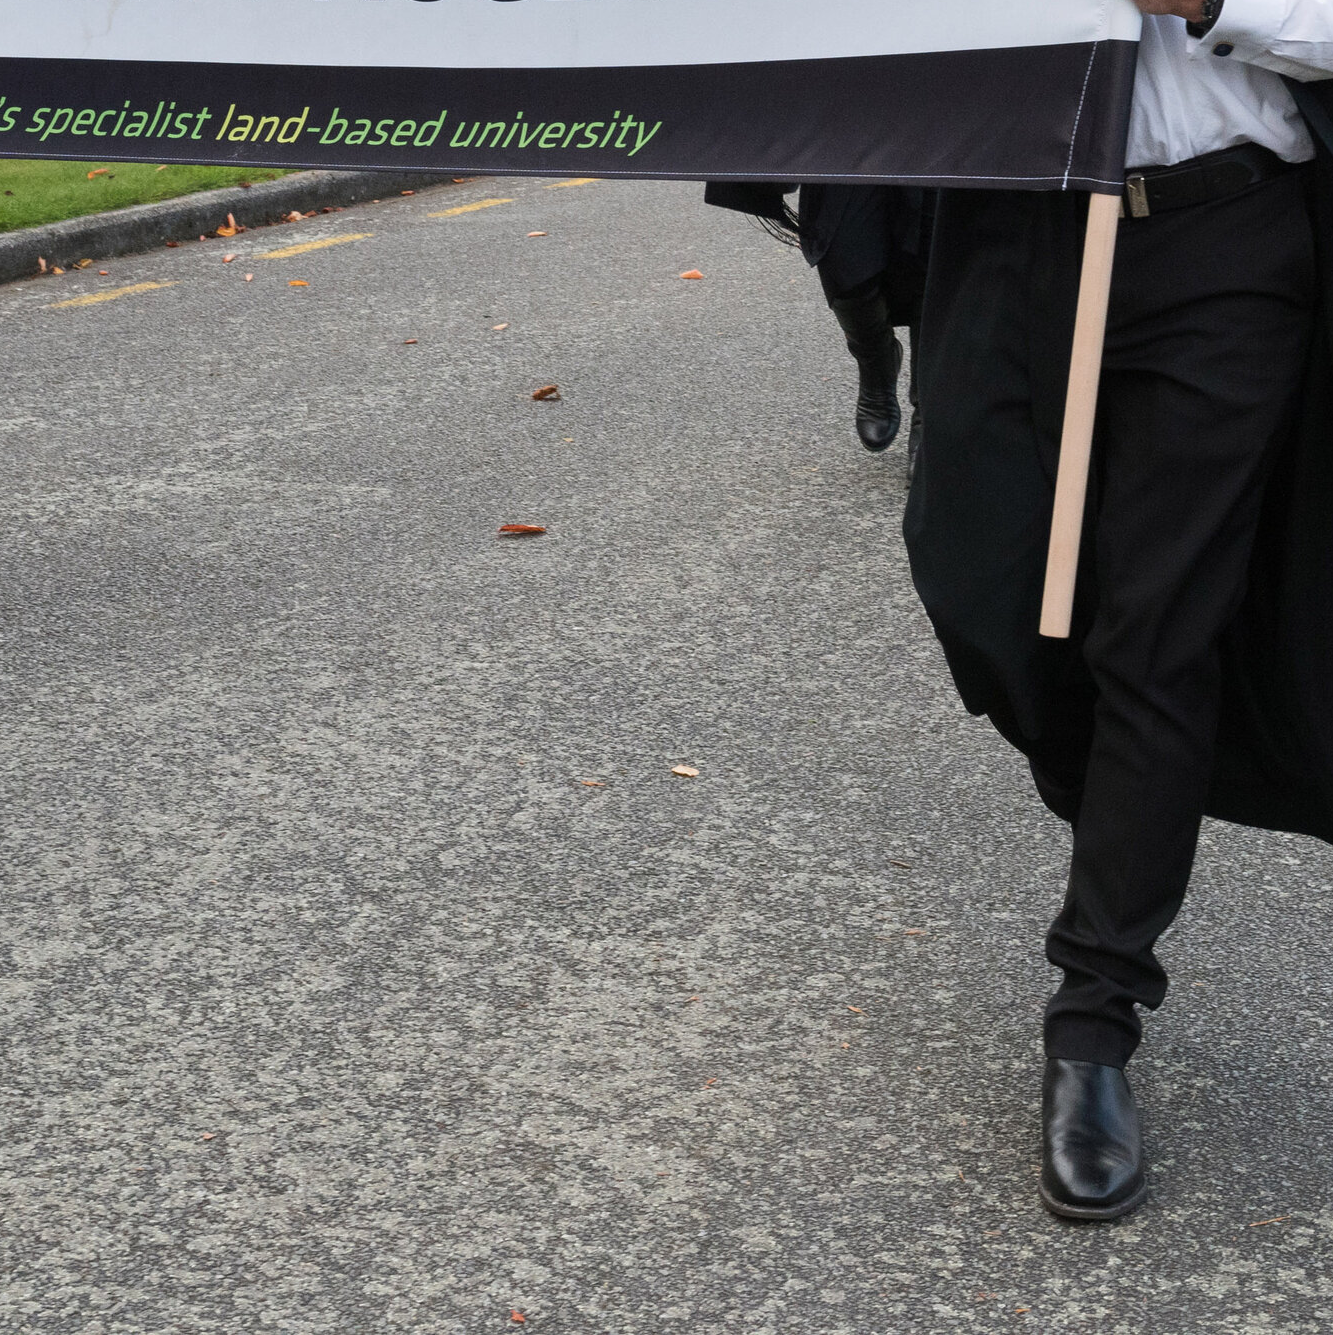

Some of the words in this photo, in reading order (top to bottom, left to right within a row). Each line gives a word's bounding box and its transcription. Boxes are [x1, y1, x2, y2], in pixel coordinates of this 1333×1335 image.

[25, 100, 212, 142] specialist
[215, 103, 448, 149] land-based
[448, 110, 663, 157] university
